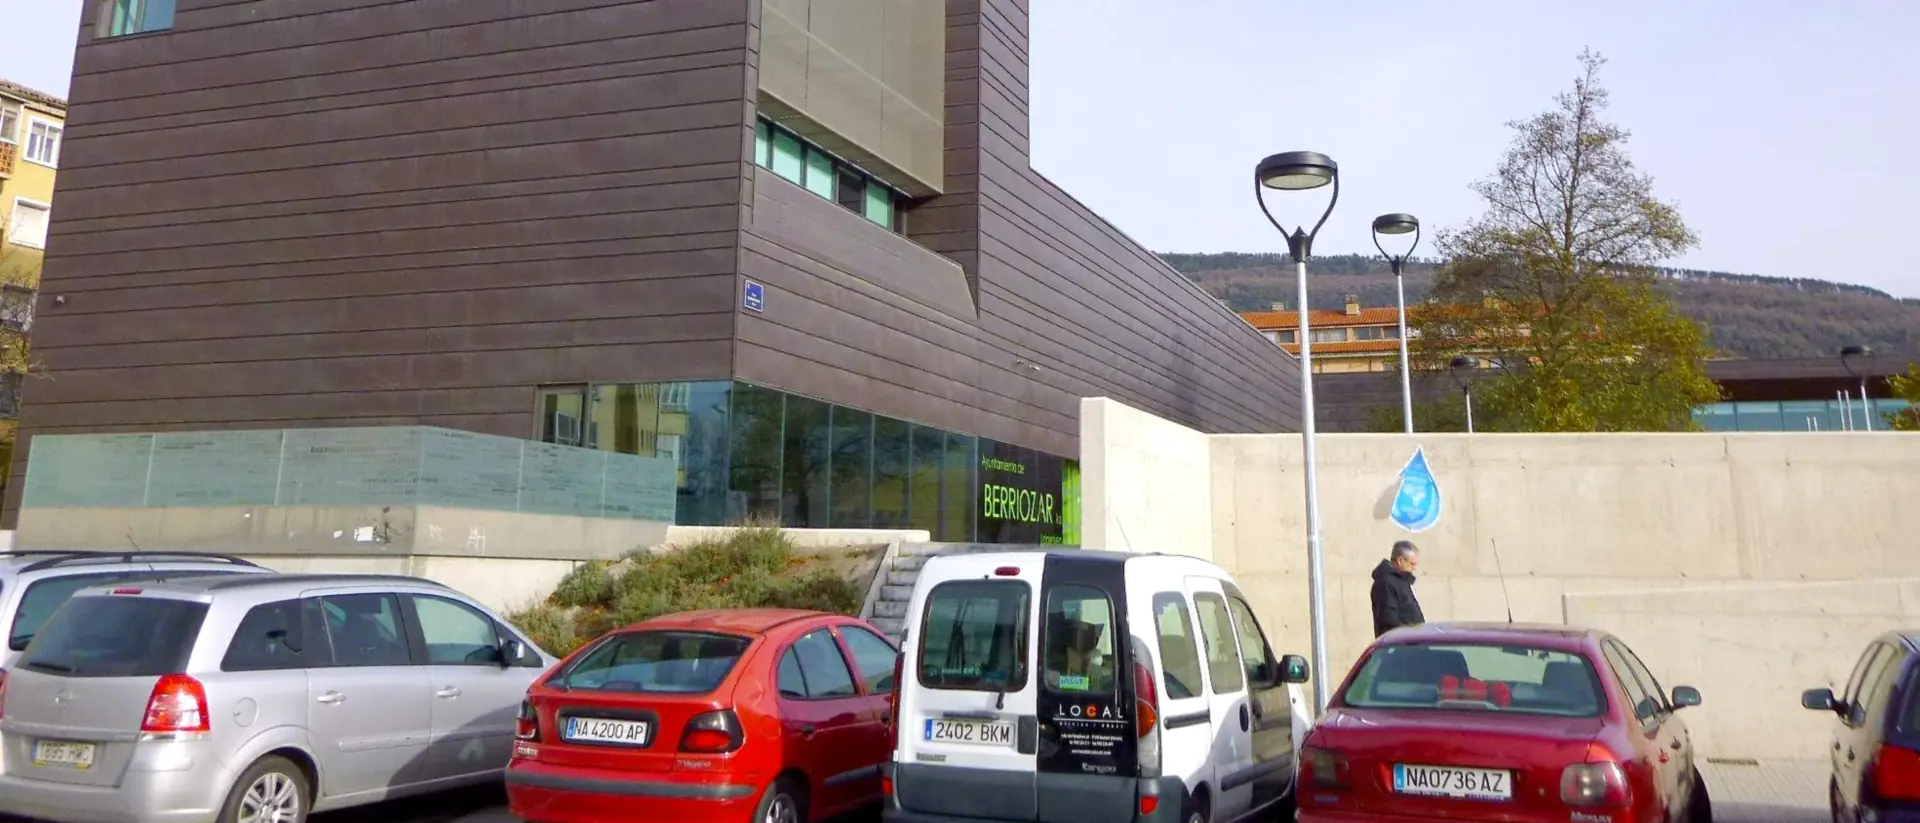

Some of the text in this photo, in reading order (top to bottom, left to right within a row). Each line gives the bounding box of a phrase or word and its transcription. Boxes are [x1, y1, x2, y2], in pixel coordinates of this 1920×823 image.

[984, 484, 1053, 524] BERRIOZAR
[1059, 702, 1123, 719] LOCAL
[575, 720, 644, 741] NA 4200 AP
[935, 722, 1010, 742] 2402 BKM
[1480, 771, 1504, 792] AZ
